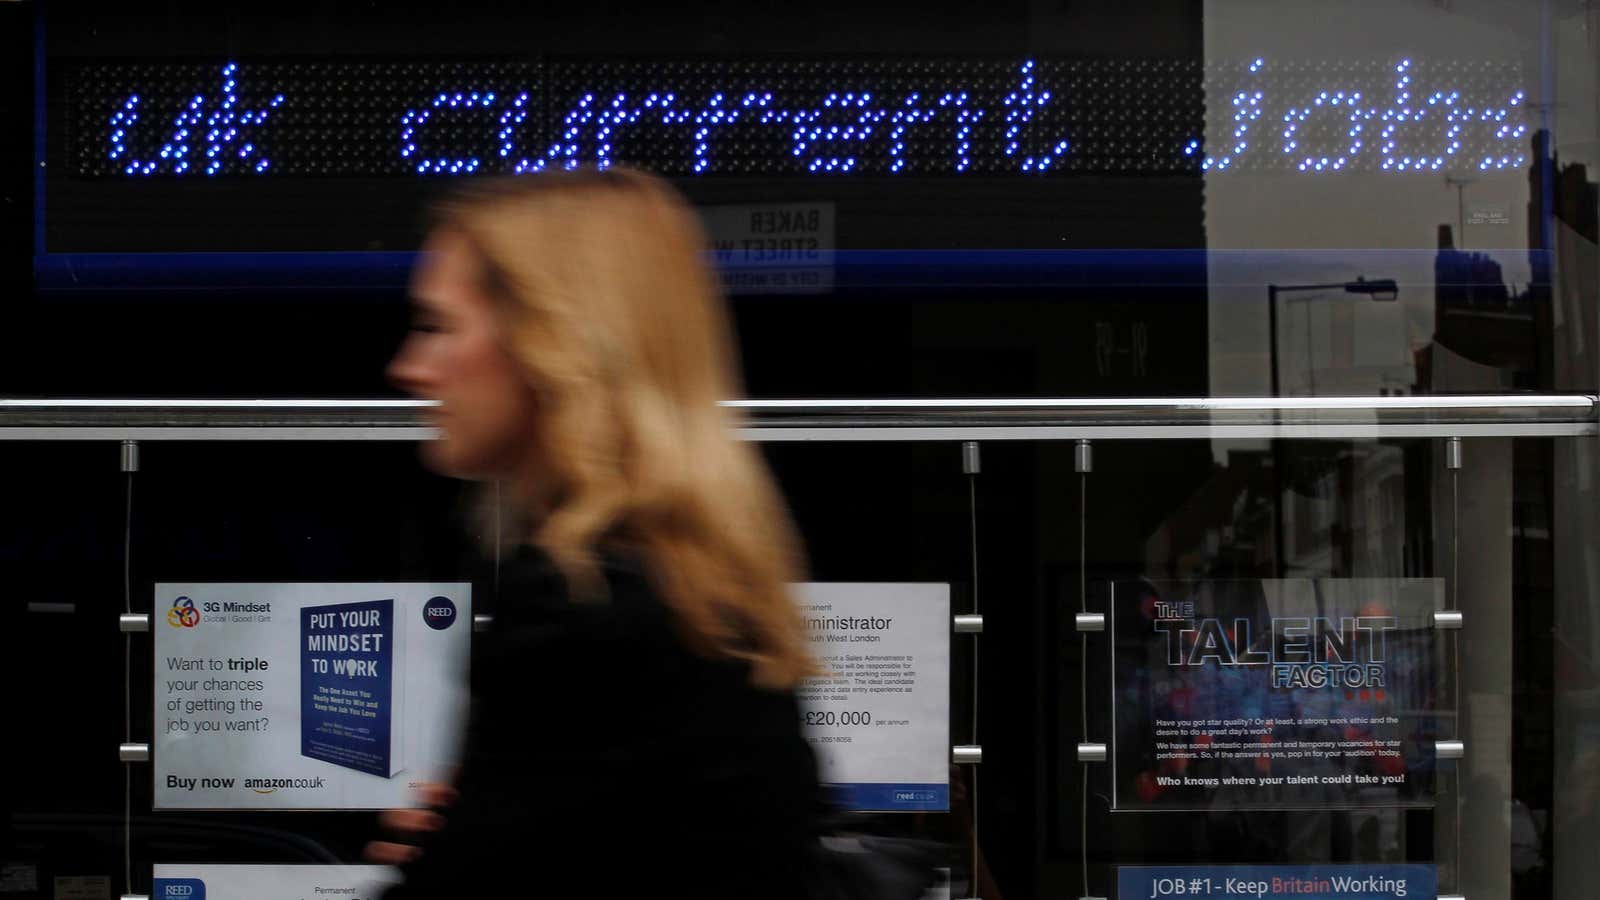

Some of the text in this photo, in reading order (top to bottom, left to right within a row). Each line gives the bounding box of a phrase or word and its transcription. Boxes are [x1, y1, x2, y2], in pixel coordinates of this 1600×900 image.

[109, 56, 1527, 175] uk current jobs
[203, 602, 271, 612] 3G Mindset
[427, 607, 452, 617] REED
[1154, 601, 1194, 618] THE
[232, 615, 252, 623] Good
[310, 610, 380, 629] PUT YOUR
[308, 634, 384, 652] MINDSET
[826, 634, 848, 642] West
[850, 634, 880, 642] London
[1154, 616, 1397, 666] TALENT
[167, 657, 268, 673] Want to triple
[312, 659, 328, 674] TO
[1272, 664, 1385, 688] FACTOR
[167, 678, 264, 693] your chances
[167, 698, 263, 714] of getting the
[166, 717, 269, 734] job you want?
[1223, 718, 1252, 727] quality?
[1275, 718, 1296, 726] least,
[1304, 718, 1328, 726] strong
[1190, 728, 1200, 736] do
[1208, 728, 1228, 737] great
[1228, 728, 1249, 736] day's
[1250, 727, 1272, 735] work?
[1243, 742, 1282, 750] permanent
[1299, 741, 1336, 749] temporary
[1156, 752, 1199, 760] performers.
[1378, 750, 1400, 758] today.
[167, 775, 235, 791] Buy now
[1156, 774, 1405, 786] Who knows where your talent could take you!
[165, 885, 193, 896] REED
[314, 887, 356, 895] Permanent
[1150, 878, 1185, 898] JOB
[1188, 878, 1211, 894] #1
[1225, 878, 1268, 898] Keep
[1272, 877, 1330, 894] Britain
[1331, 876, 1407, 897] Working
